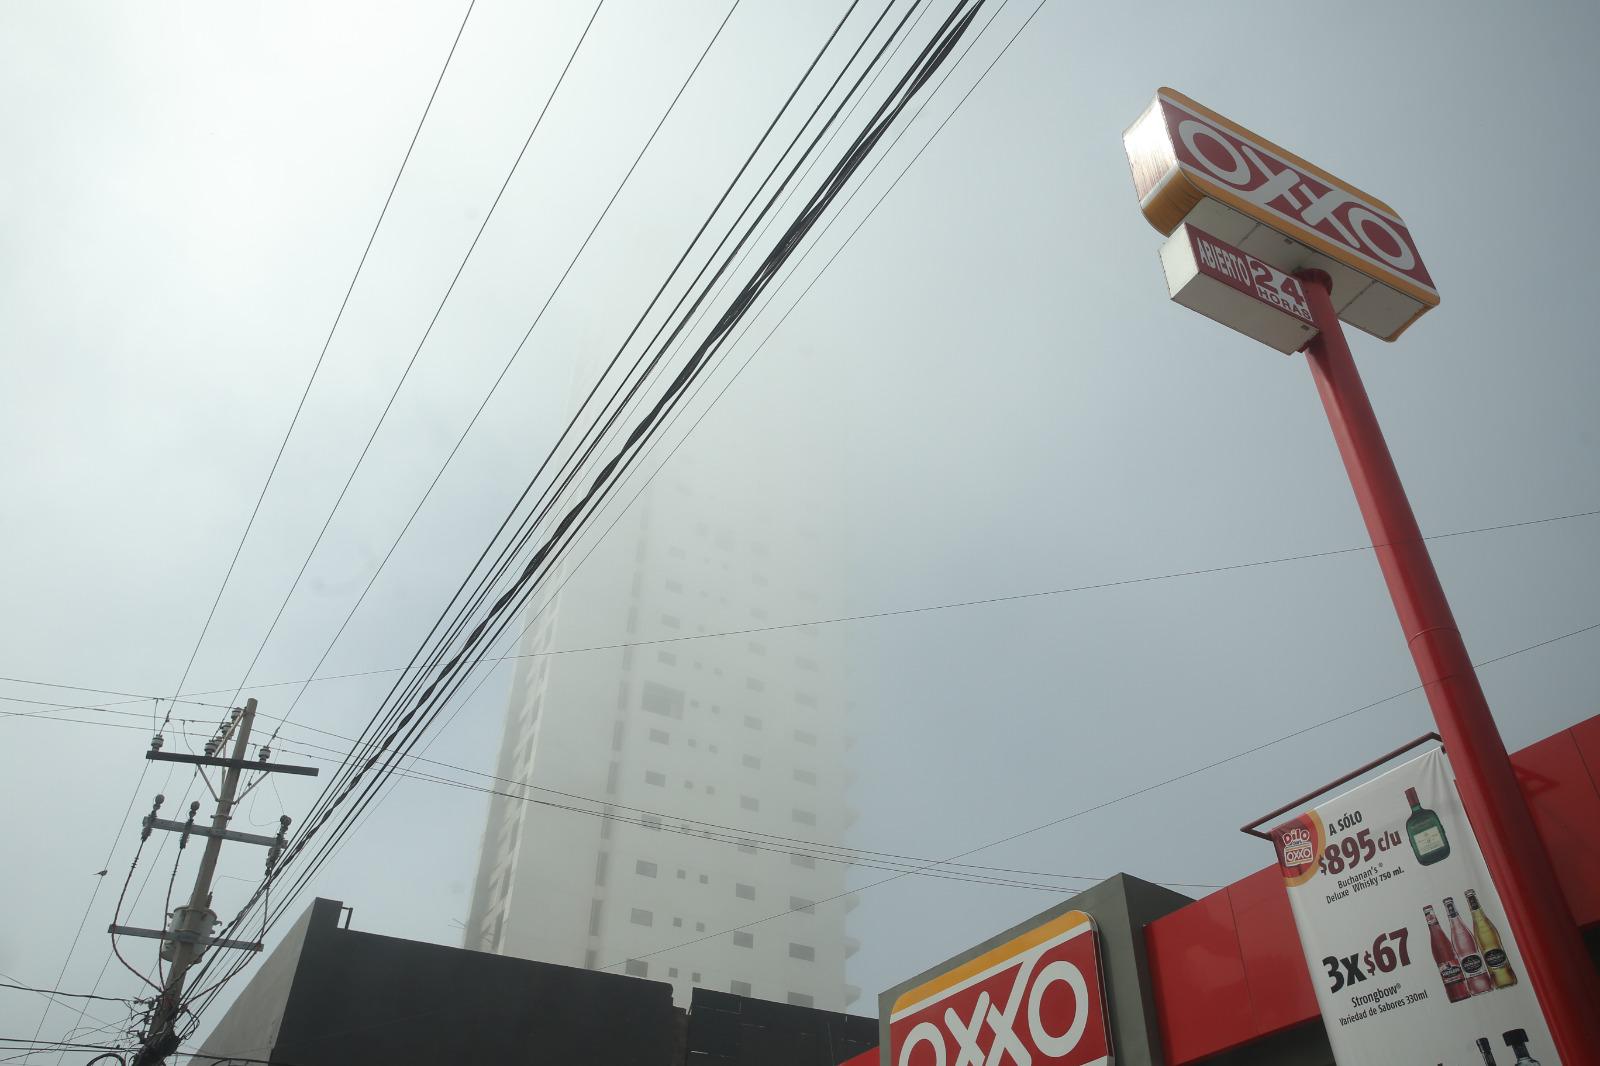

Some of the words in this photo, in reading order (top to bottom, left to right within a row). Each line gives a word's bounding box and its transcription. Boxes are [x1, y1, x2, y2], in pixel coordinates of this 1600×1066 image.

[1179, 120, 1415, 270] OXXO
[1197, 237, 1250, 287] ABIERTO
[1250, 260, 1305, 306] 24
[1258, 286, 1311, 320] HORAS
[1328, 823, 1337, 836] A
[1338, 810, 1363, 832] SÓLO
[1326, 887, 1350, 904] Deluxe
[1351, 876, 1379, 893] Whisky
[1378, 871, 1392, 882] 750
[898, 950, 1089, 1066] OXXO
[1338, 1009, 1368, 1027] Variedad
[1368, 1007, 1377, 1017] de
[1377, 997, 1406, 1014] Sabores
[1405, 989, 1429, 1005] 330ml
